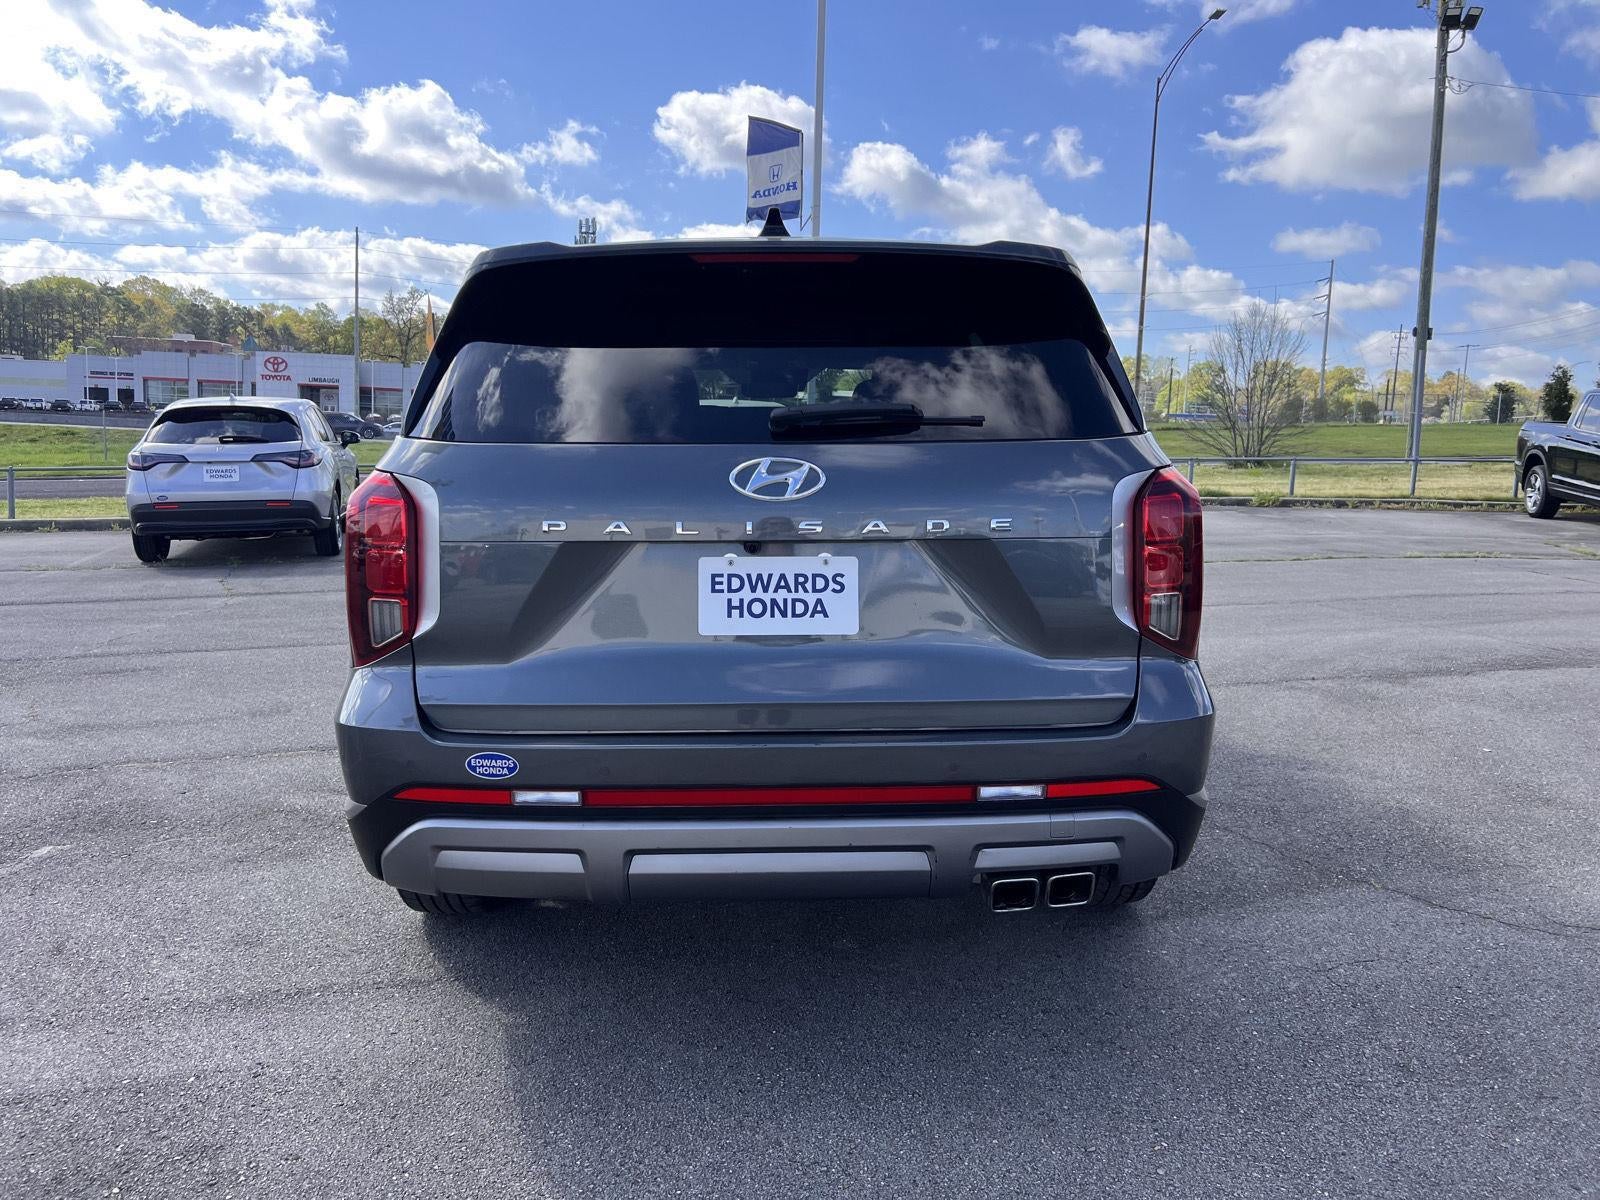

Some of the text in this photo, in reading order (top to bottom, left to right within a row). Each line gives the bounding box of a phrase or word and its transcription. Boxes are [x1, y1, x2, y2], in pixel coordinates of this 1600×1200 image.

[541, 517, 1013, 535] PALISADE
[710, 573, 846, 594] EDWARDS
[726, 597, 829, 618] HONDA
[470, 758, 514, 767] EDWARDS
[476, 767, 509, 775] HONDA
